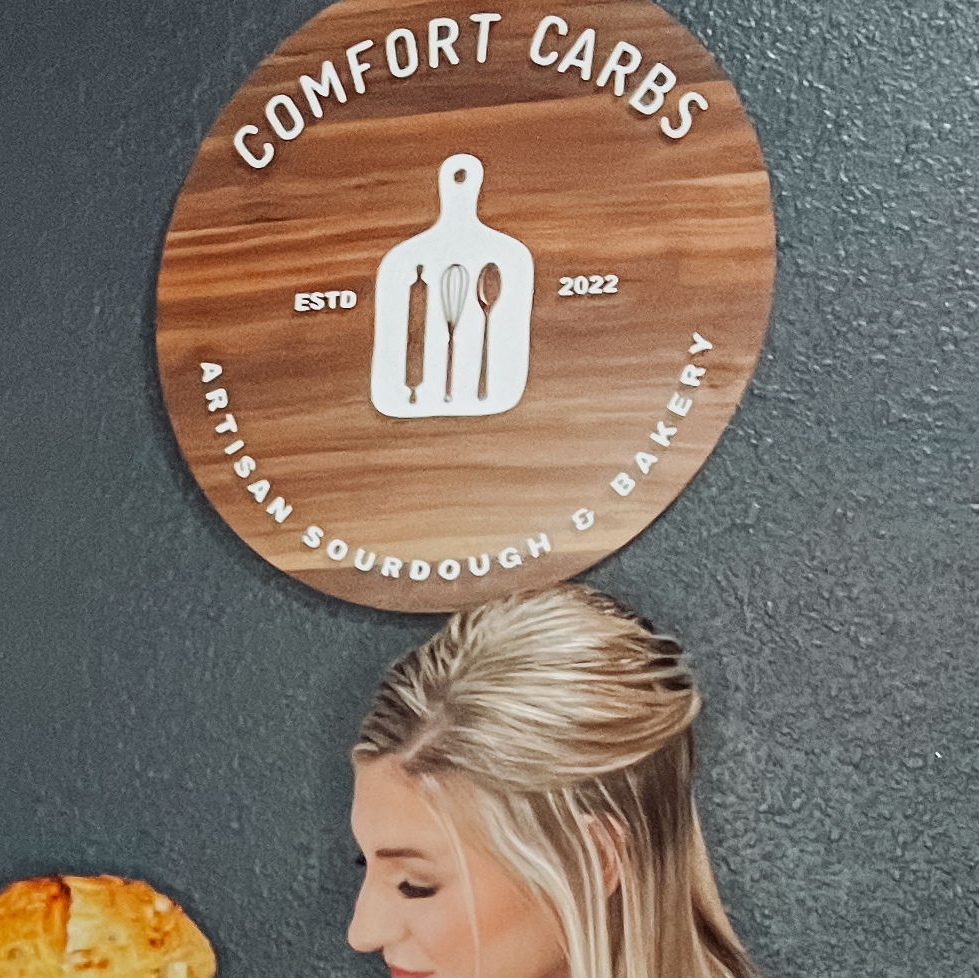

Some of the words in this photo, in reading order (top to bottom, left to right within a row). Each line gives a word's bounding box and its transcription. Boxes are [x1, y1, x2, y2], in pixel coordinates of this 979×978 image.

[233, 13, 502, 169] COMFORT
[529, 15, 709, 139] CARBS
[293, 290, 357, 312] ESTD
[557, 274, 619, 297] 2022
[199, 361, 293, 524] ARTISAN
[302, 525, 552, 581] SOURDOUGH
[610, 332, 713, 497] BAKERY
